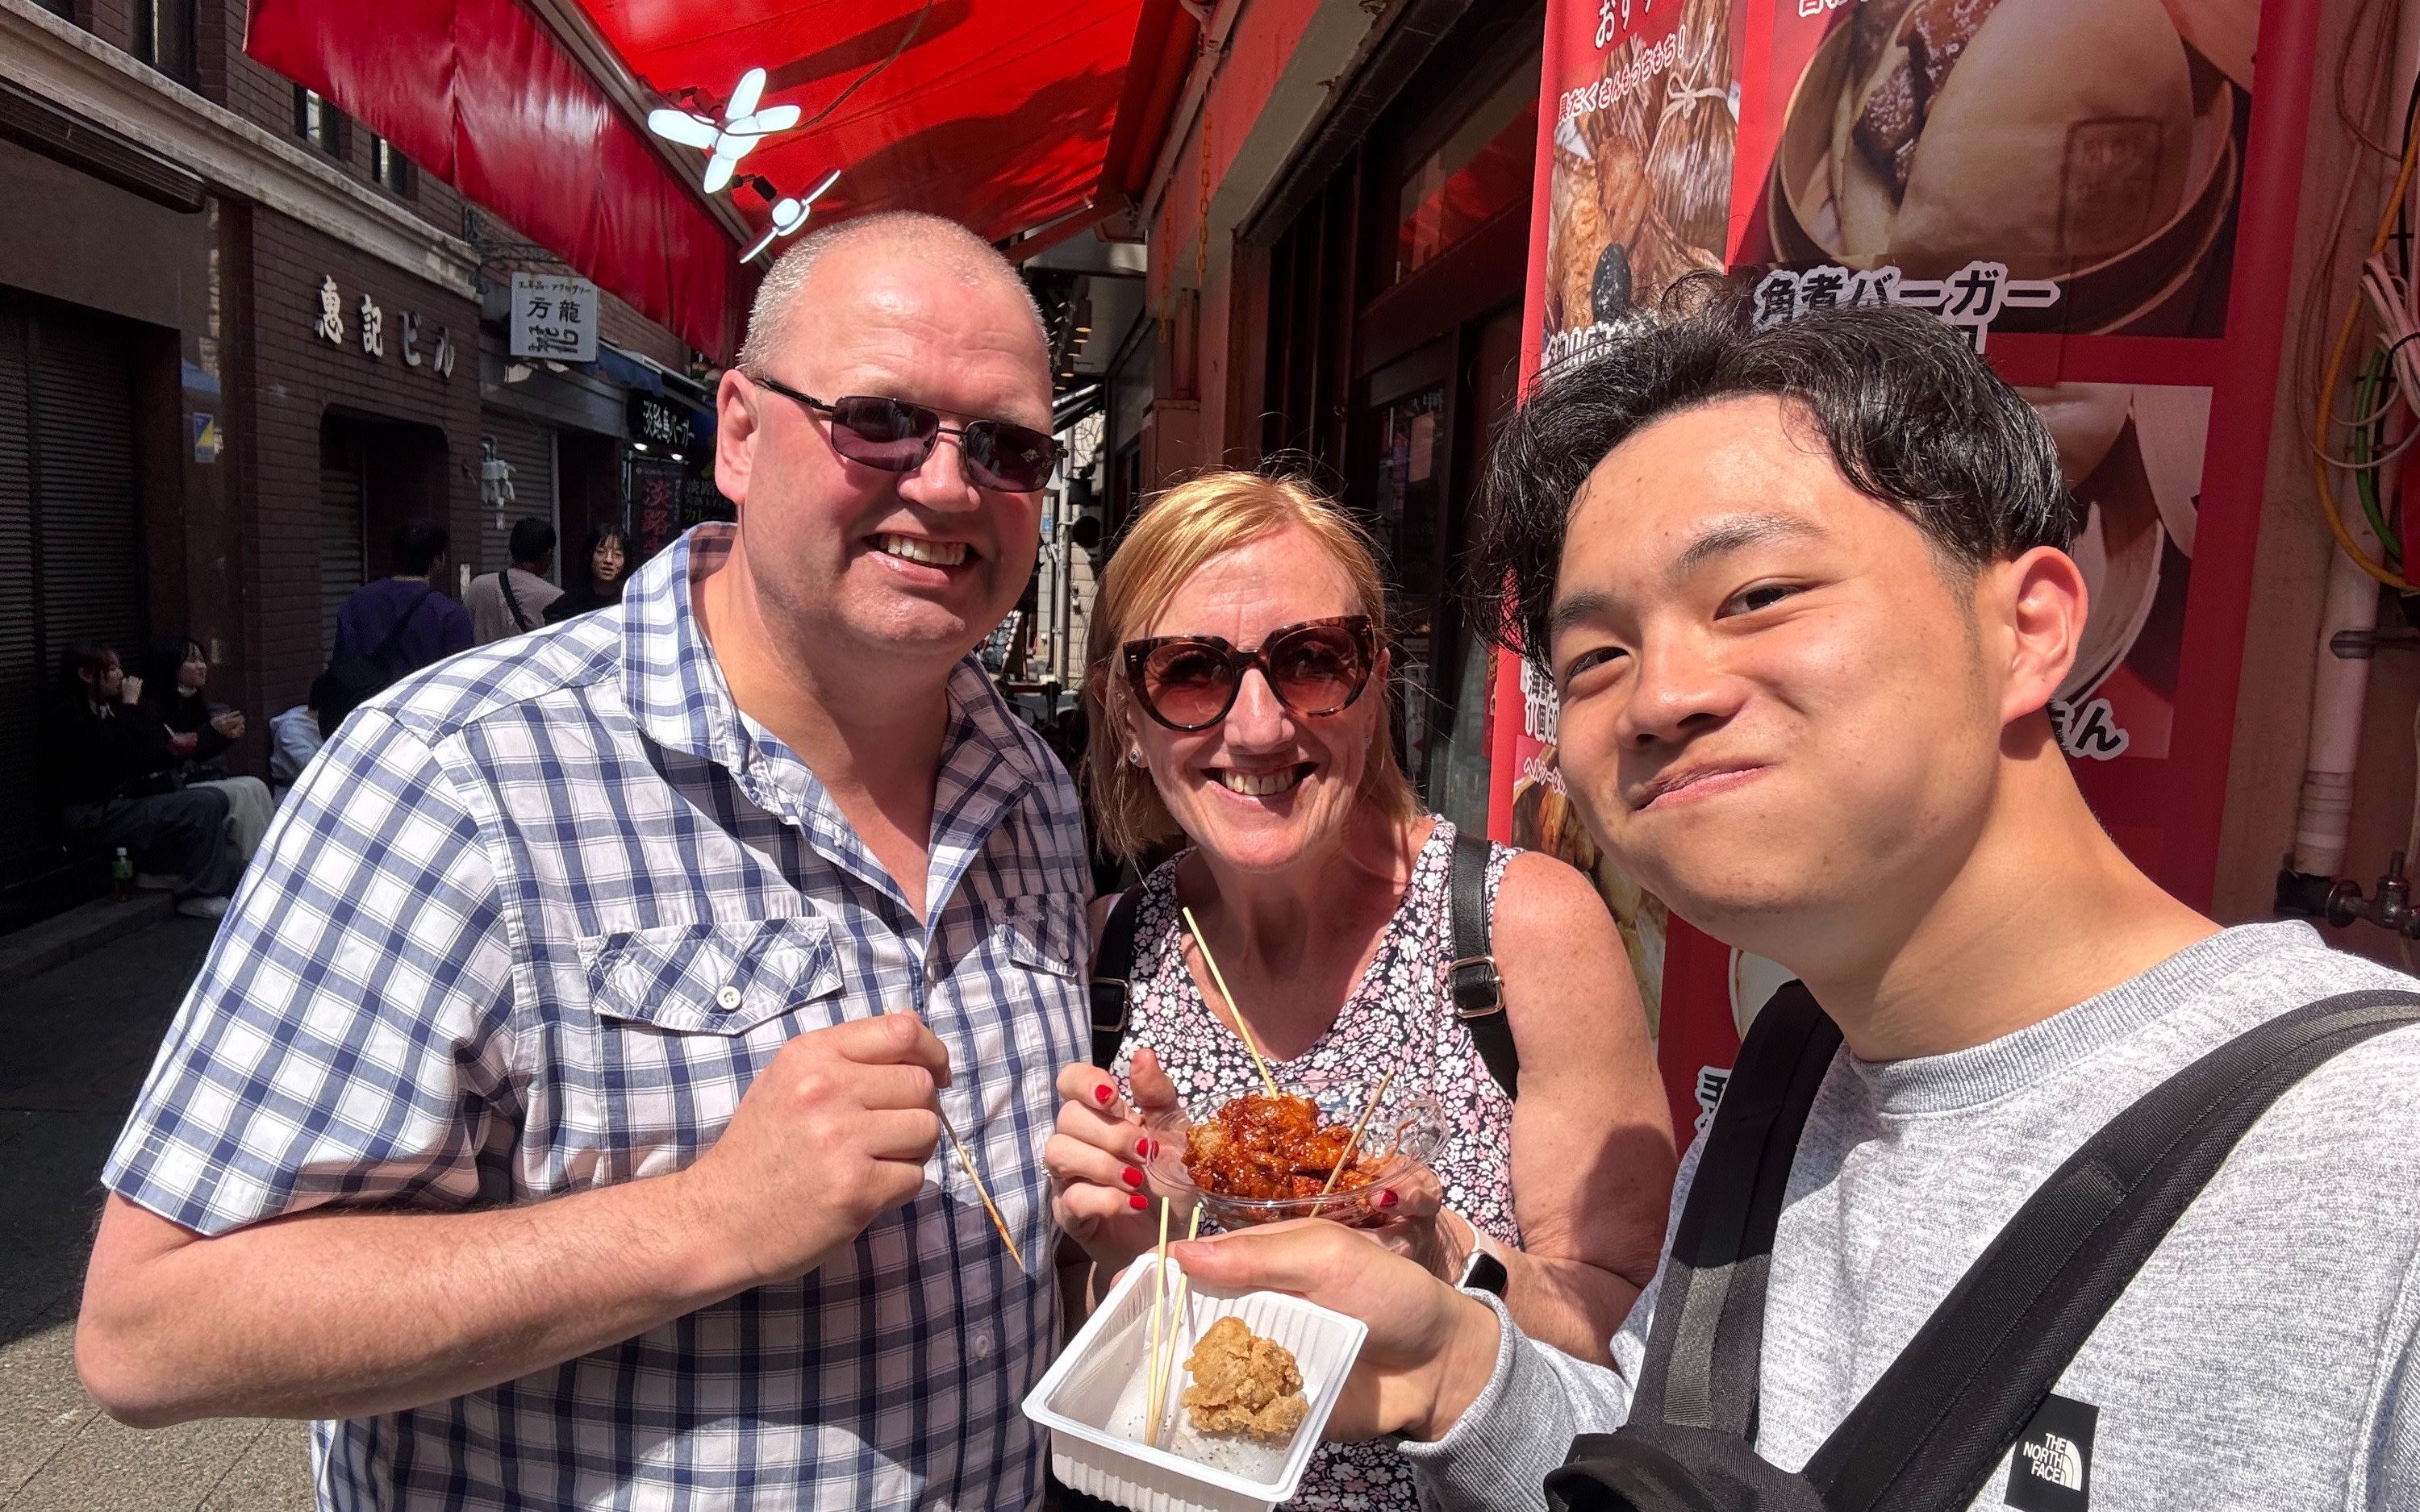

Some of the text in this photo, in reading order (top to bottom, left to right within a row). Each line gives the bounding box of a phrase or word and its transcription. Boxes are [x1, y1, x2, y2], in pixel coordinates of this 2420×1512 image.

[2023, 1441, 2063, 1468] NORTH
[2046, 1433, 2067, 1454] THE
[2031, 1460, 2061, 1485] FACE
